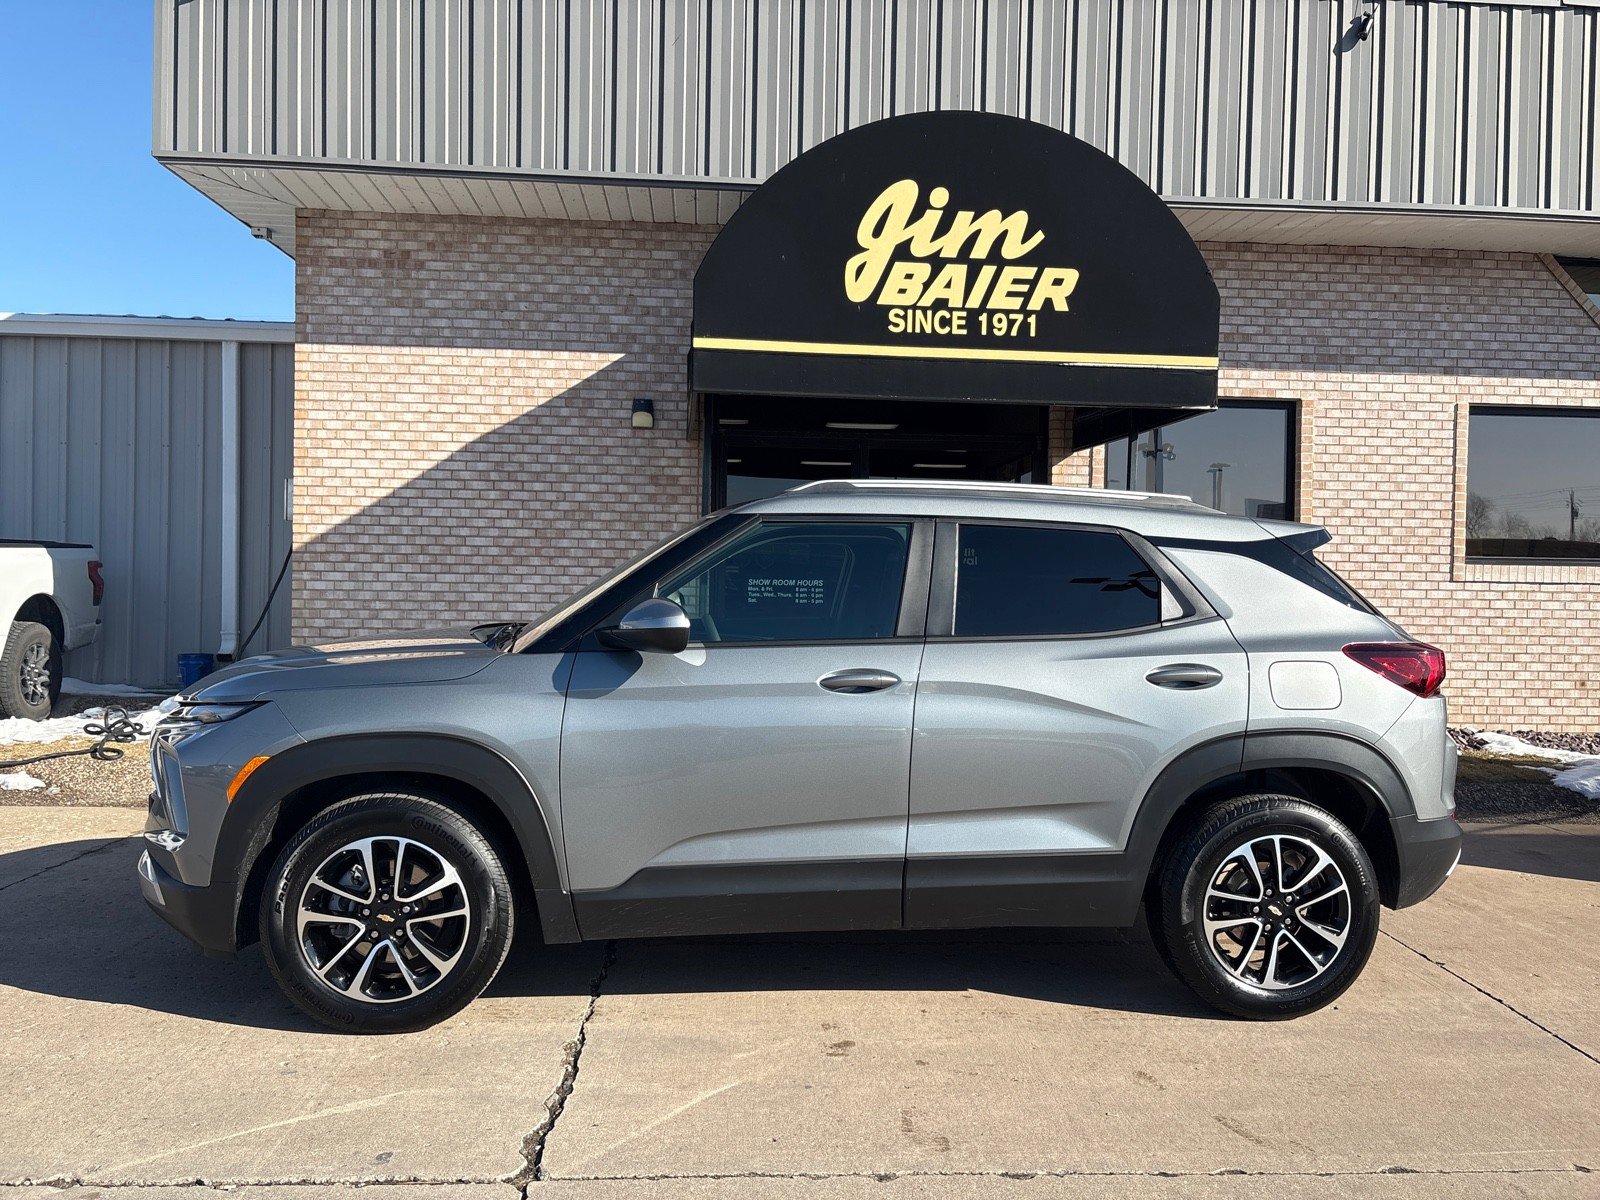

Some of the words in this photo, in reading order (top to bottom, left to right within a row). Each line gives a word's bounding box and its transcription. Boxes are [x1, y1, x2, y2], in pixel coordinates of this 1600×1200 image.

[845, 179, 1045, 302] Jim
[876, 261, 1080, 312] BAIER
[888, 308, 967, 335] SINCE
[978, 312, 1037, 337] 1971
